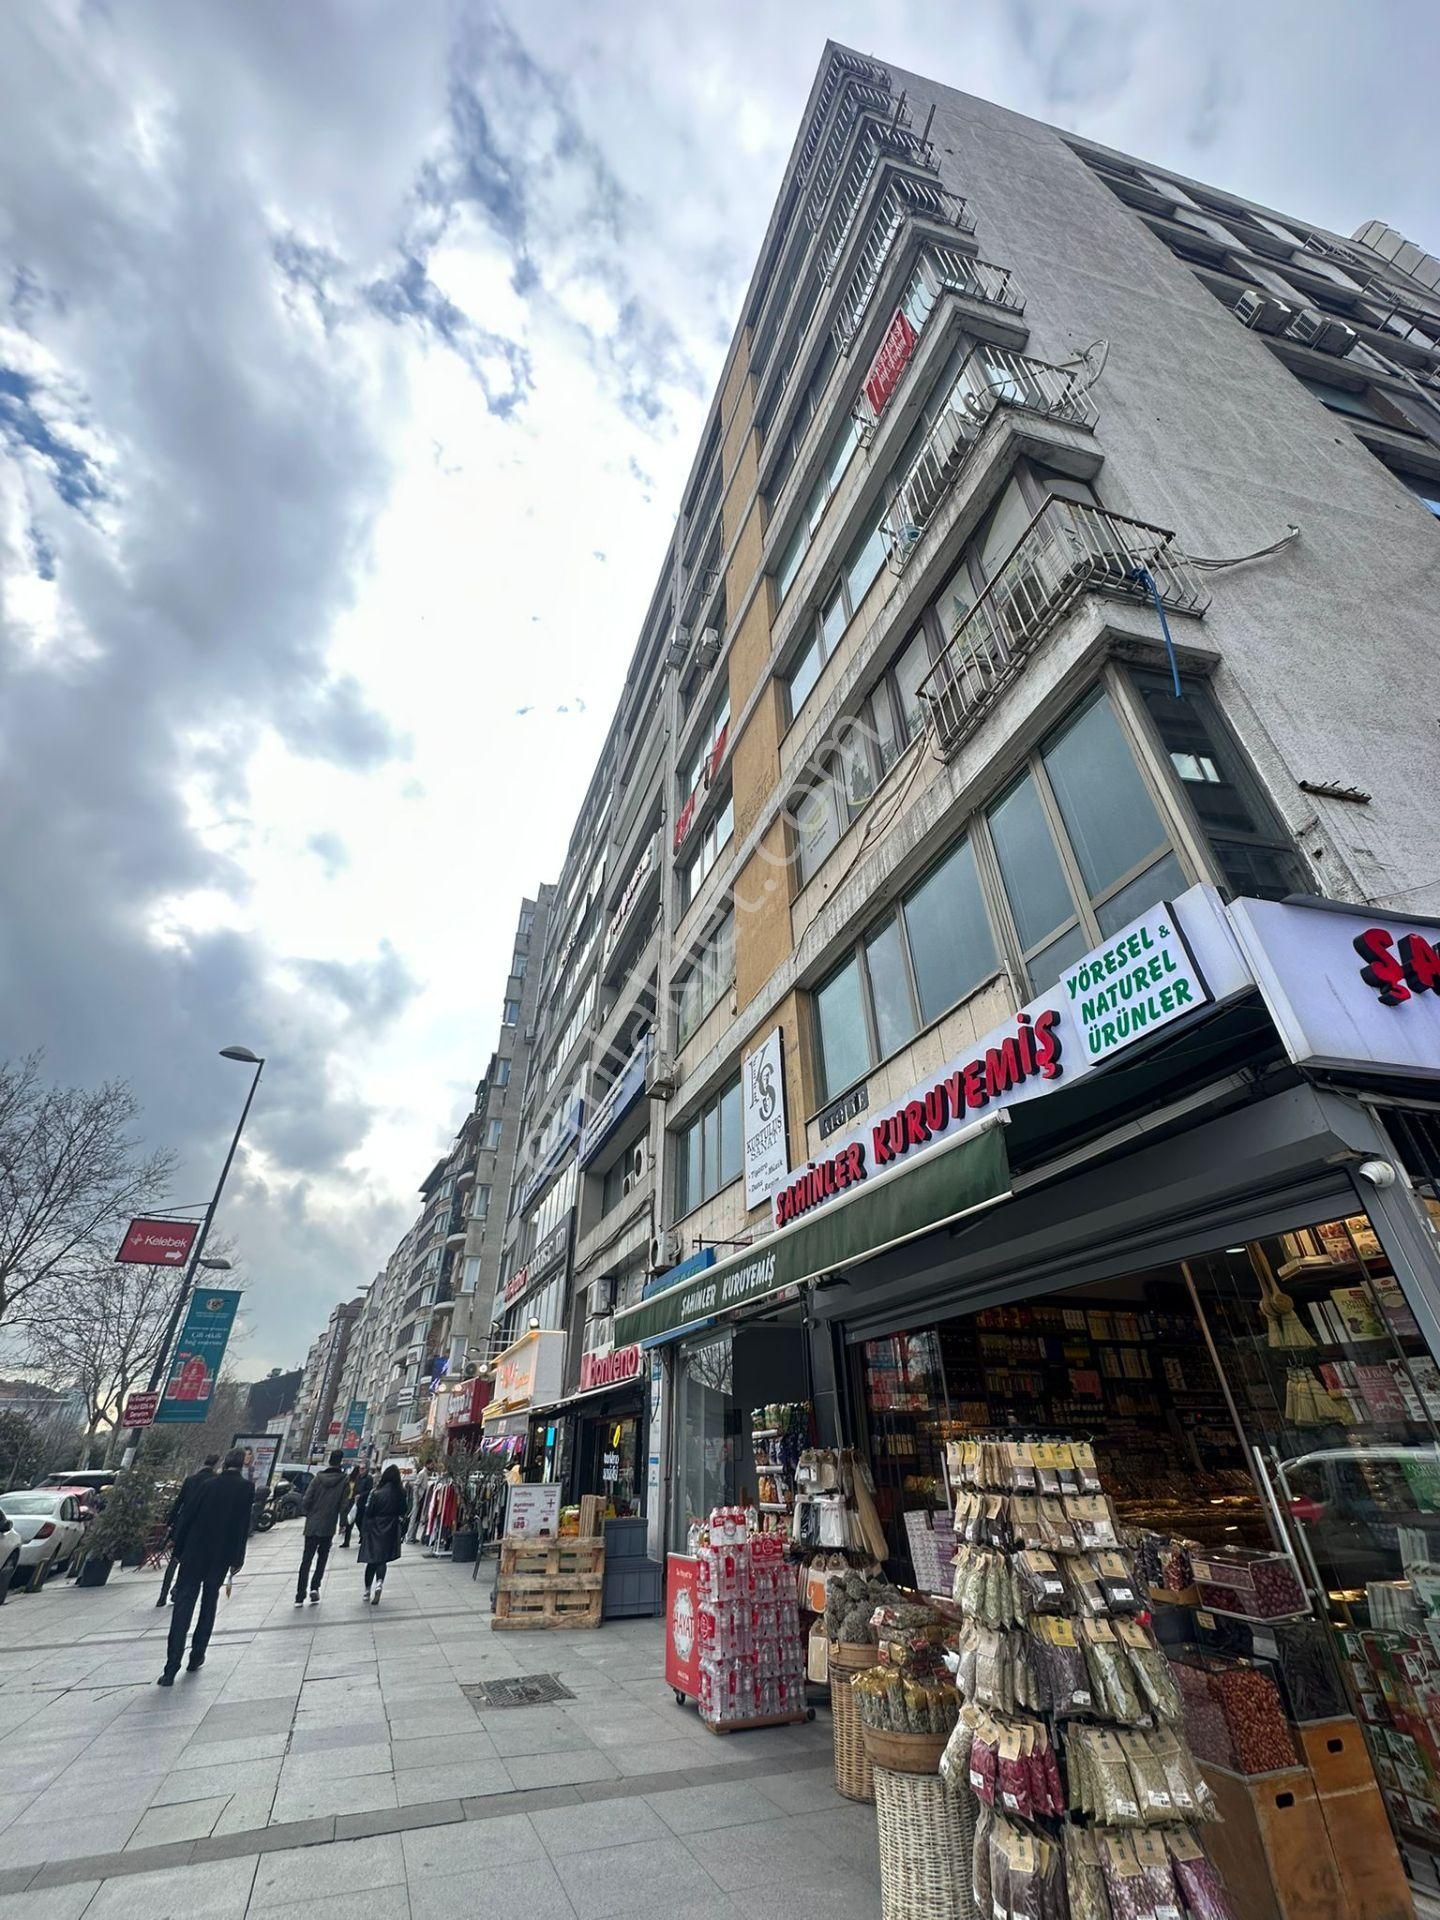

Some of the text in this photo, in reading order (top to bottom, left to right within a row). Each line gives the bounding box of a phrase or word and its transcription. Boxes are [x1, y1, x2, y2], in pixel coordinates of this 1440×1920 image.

[1066, 925, 1170, 1000] YÖRESEL &
[1081, 949, 1177, 1026] NATUREL
[1353, 928, 1440, 1006] ŞA
[1088, 978, 1193, 1054] ÜRÜNLER
[872, 1010, 1064, 1165] KURUYEMİŞ
[144, 1235, 187, 1248] Kelebek
[681, 1282, 717, 1321] ŞAHİNLER
[722, 1250, 776, 1301] KURUYEMİŞ
